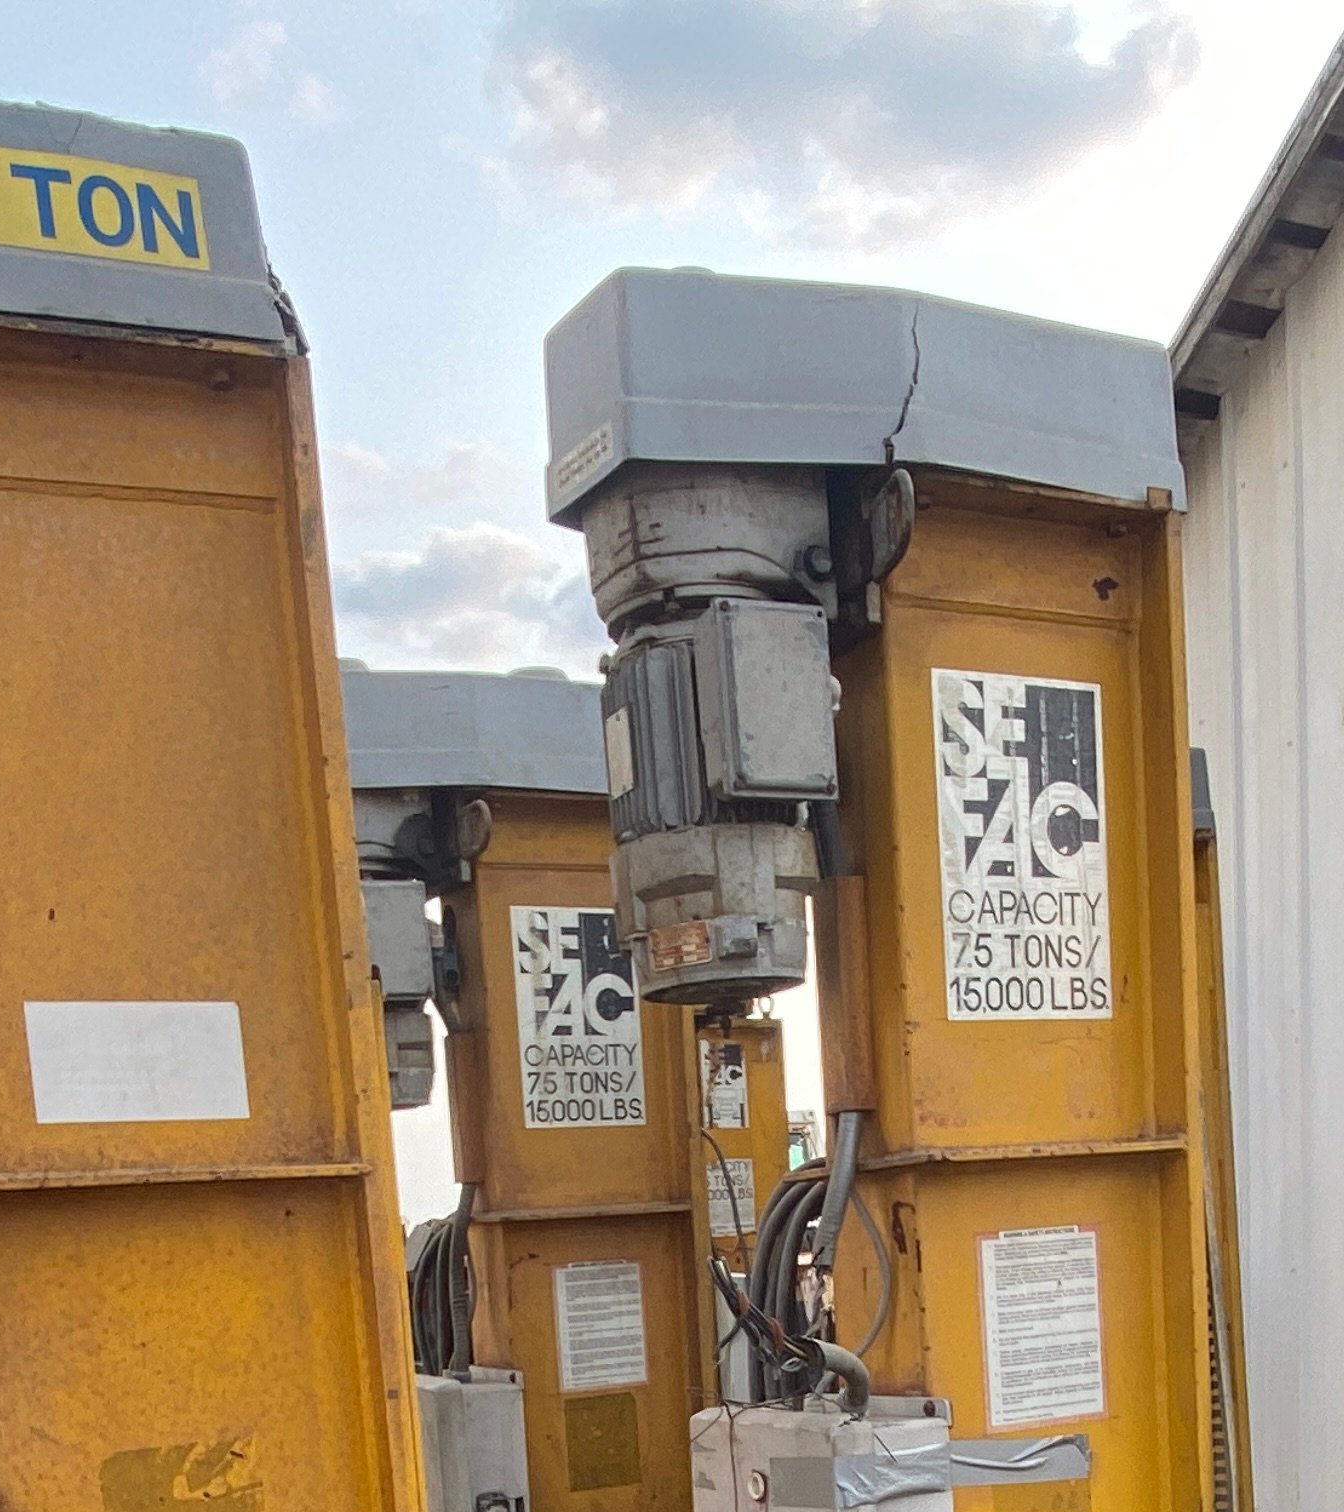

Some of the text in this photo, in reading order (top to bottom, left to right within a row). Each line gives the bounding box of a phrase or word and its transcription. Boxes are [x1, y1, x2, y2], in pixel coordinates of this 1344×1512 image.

[10, 162, 200, 259] TON
[941, 679, 1027, 778] SE
[942, 760, 1101, 878] FAC
[948, 889, 1102, 926] CAPACITY
[517, 911, 580, 973] SE
[952, 933, 1102, 969] 7.5 TONS/
[518, 964, 634, 1036] FAC
[949, 976, 1111, 1014] 15,000 LBS.
[524, 1043, 638, 1067] CAPACITY
[565, 1070, 637, 1095] TONS/
[526, 1099, 596, 1126] 15,000
